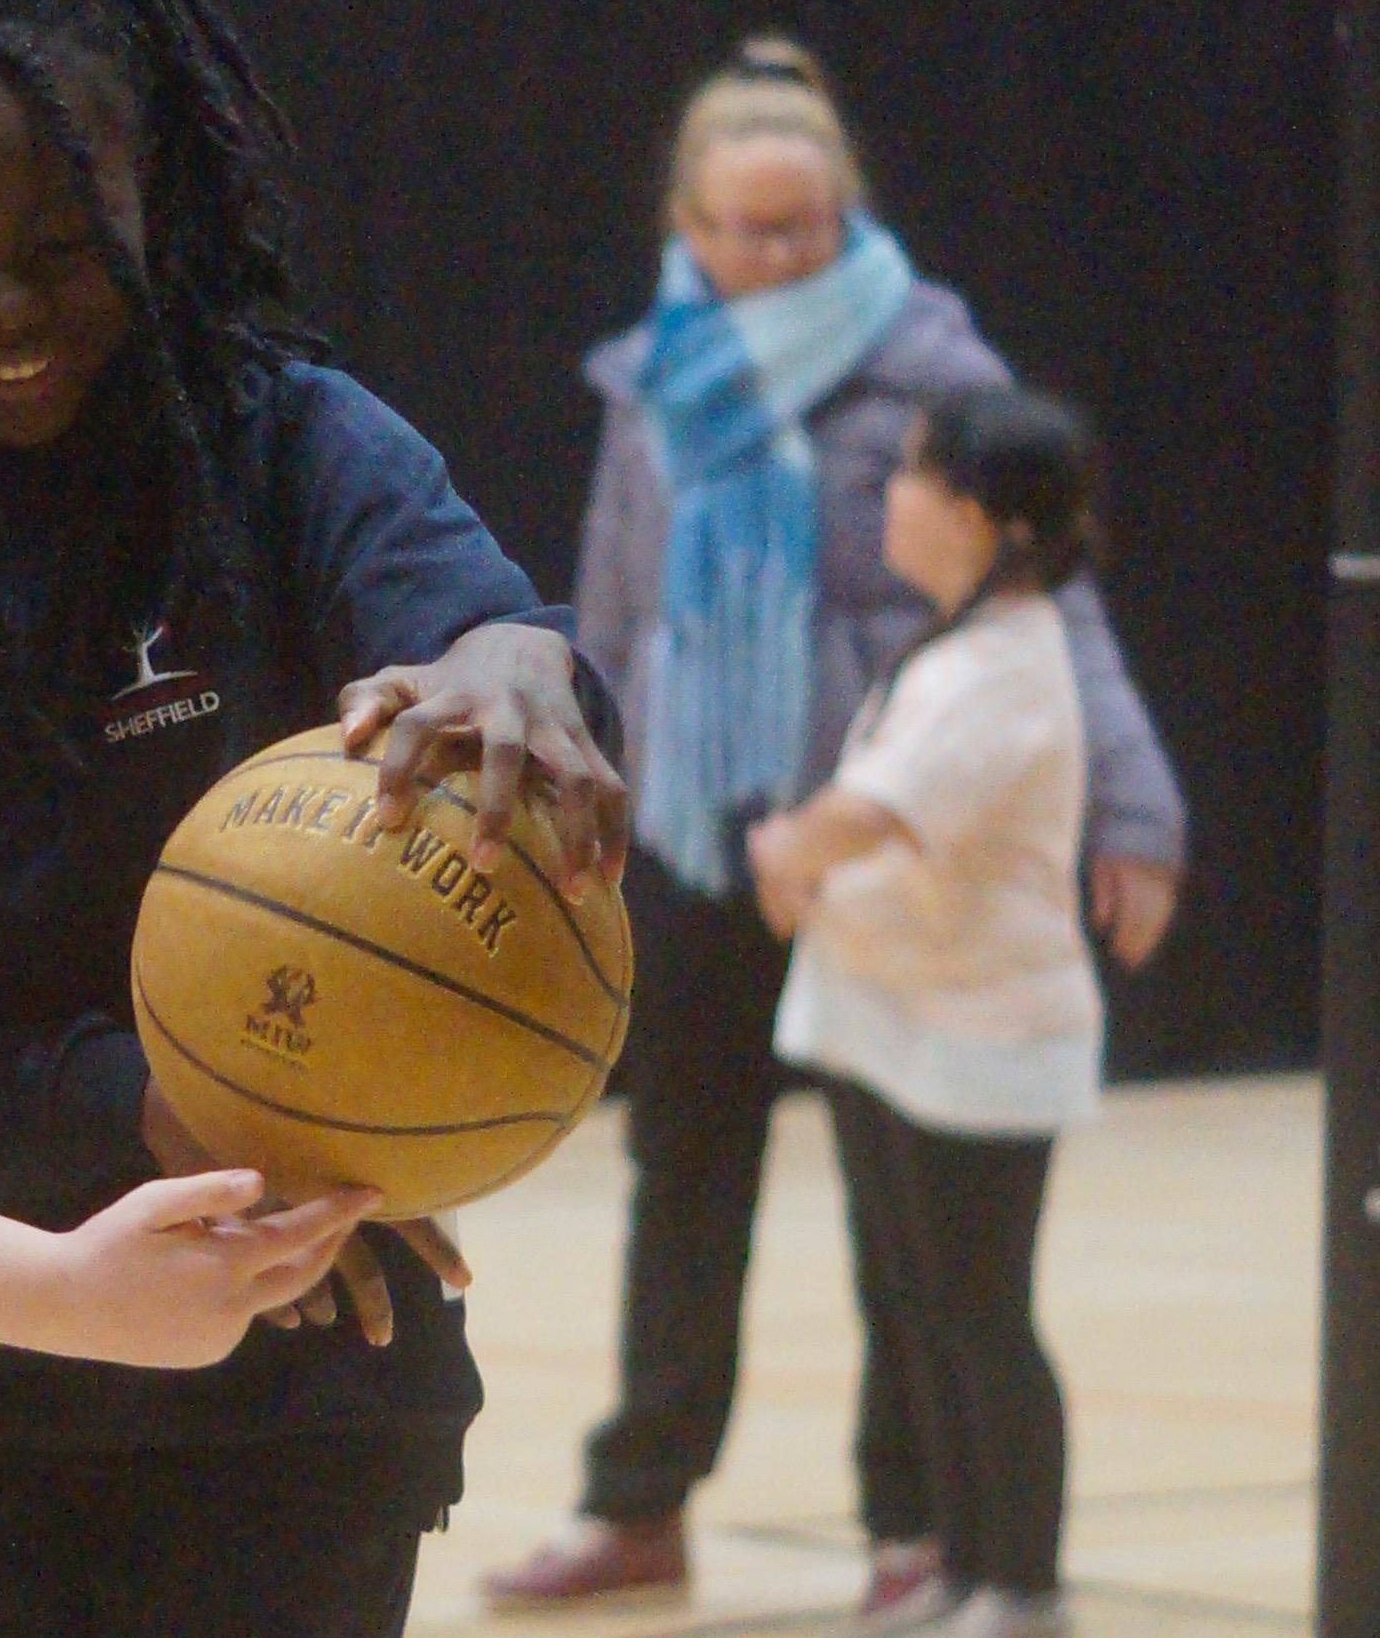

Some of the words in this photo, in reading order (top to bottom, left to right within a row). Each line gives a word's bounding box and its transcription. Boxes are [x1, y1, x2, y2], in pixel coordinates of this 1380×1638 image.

[104, 690, 221, 743] SHEFFIELD
[218, 783, 351, 835] MAKE
[396, 826, 518, 958] WORK
